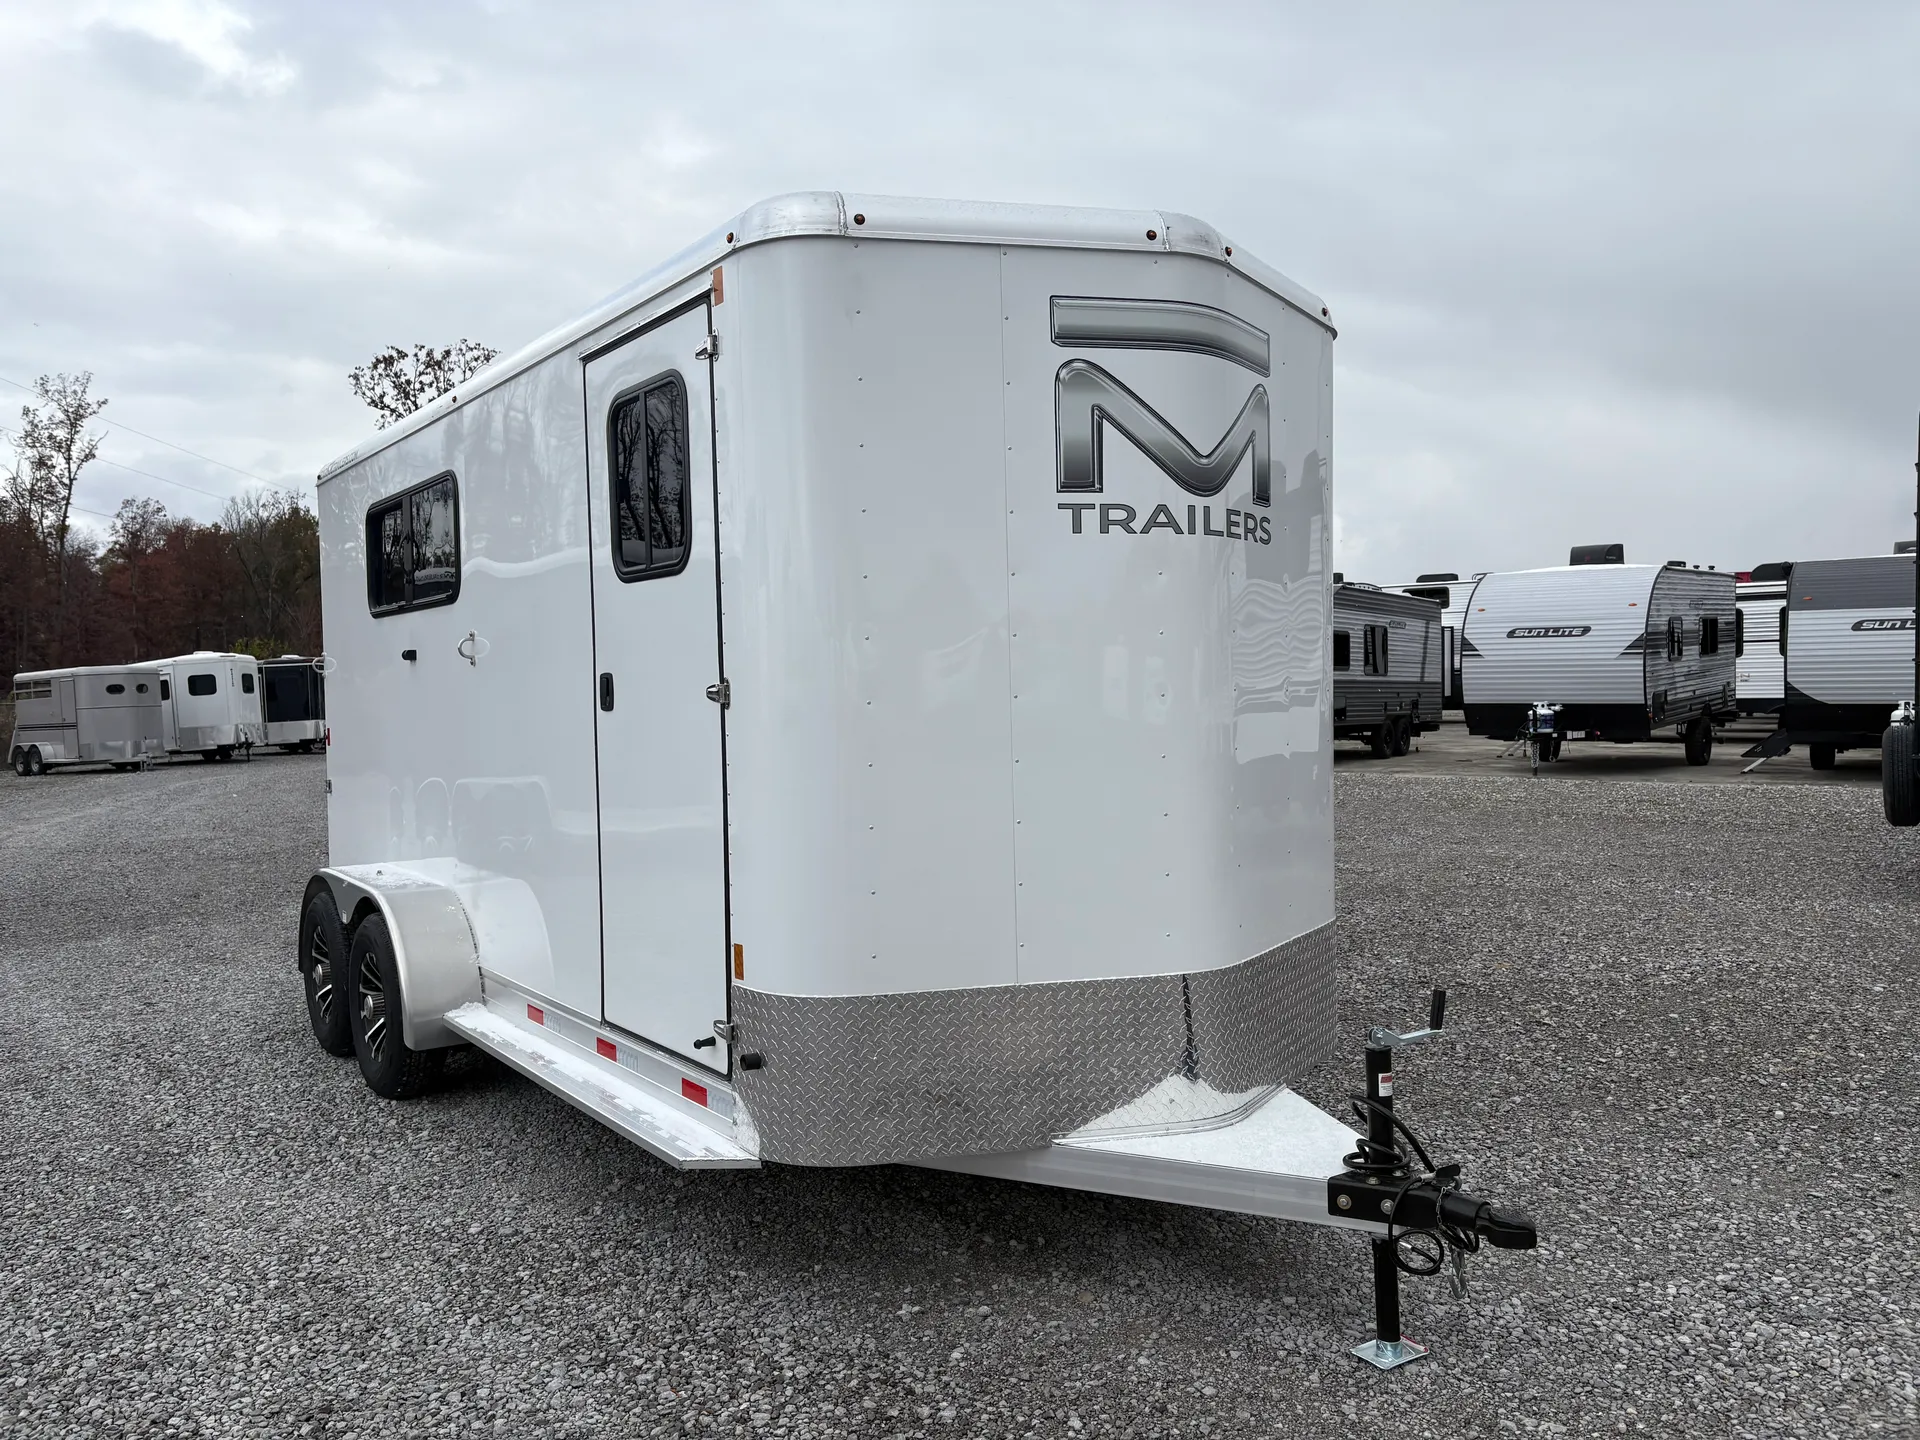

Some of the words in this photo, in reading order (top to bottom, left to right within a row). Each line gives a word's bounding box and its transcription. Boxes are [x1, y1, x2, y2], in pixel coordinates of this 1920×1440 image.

[1057, 503, 1272, 545] TRAILERS
[1860, 620, 1902, 629] SUN
[1513, 629, 1546, 637] SUN
[1547, 627, 1585, 636] LITE
